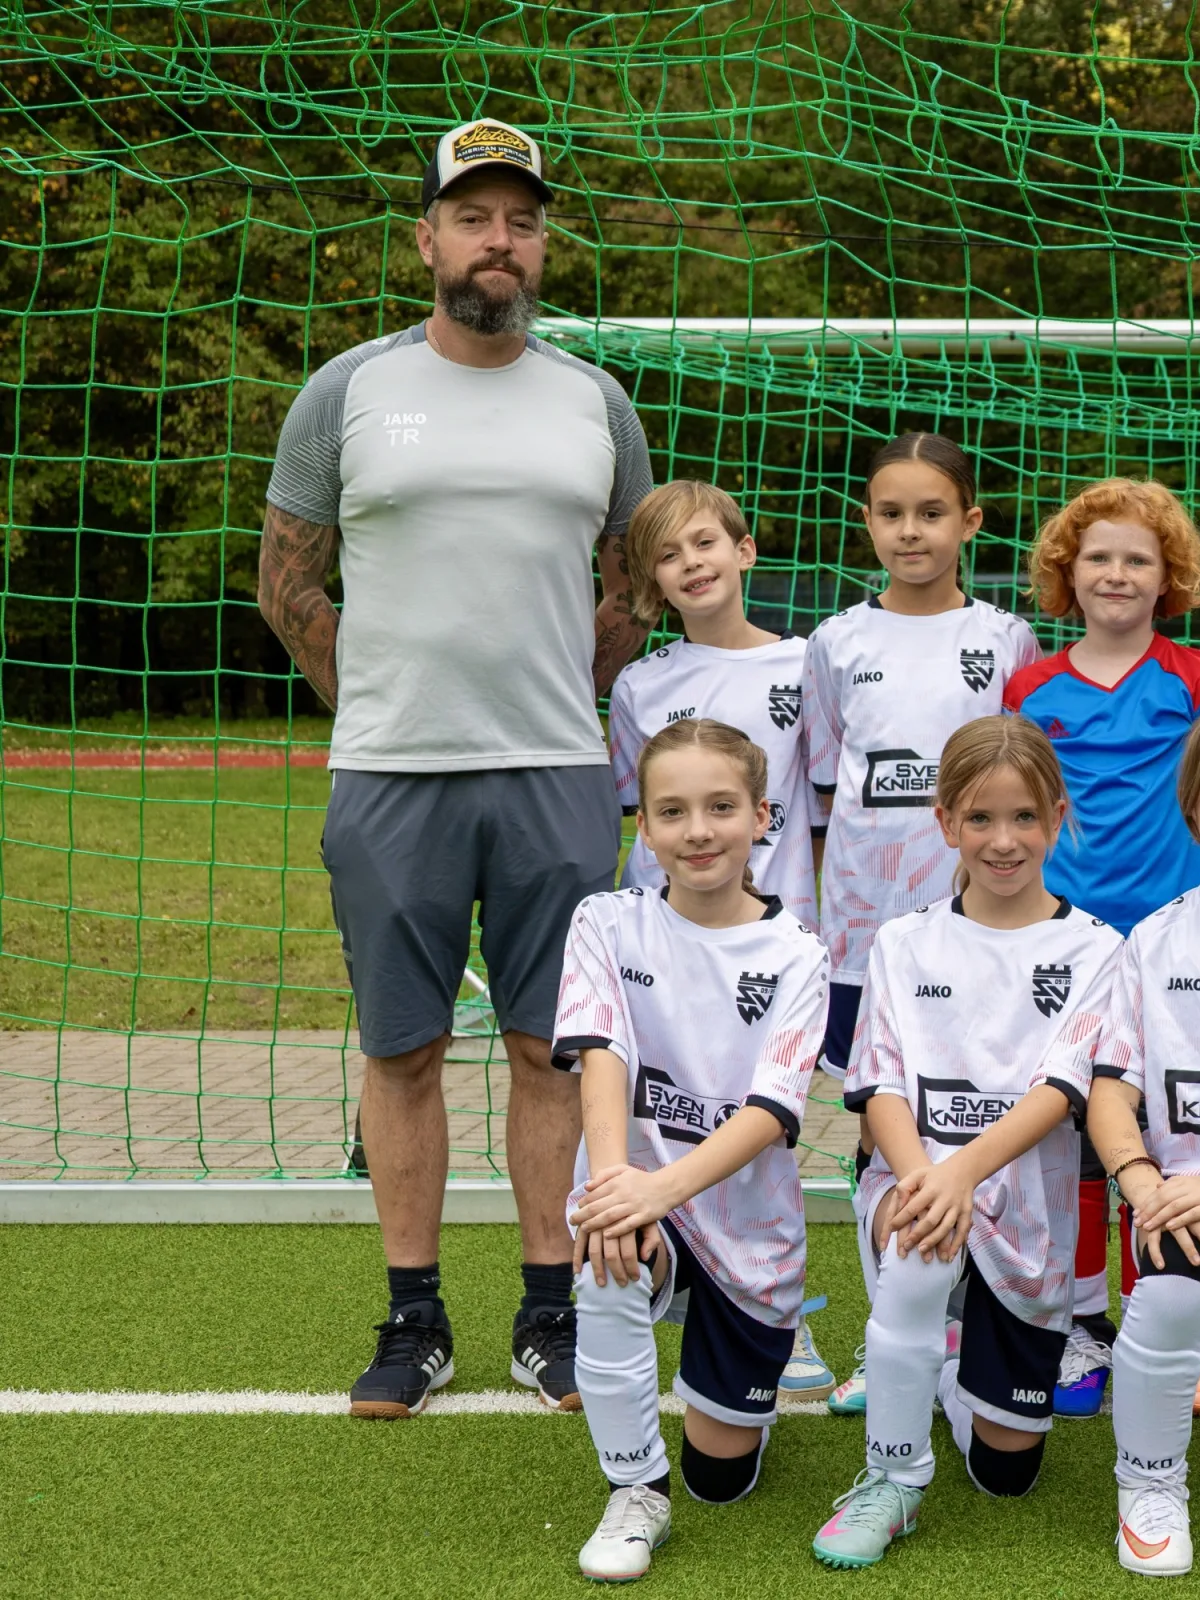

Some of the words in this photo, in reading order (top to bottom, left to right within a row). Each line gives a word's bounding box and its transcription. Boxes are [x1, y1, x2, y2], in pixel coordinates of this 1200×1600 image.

[455, 124, 529, 149] Stetson
[457, 146, 497, 158] AMERICAN
[498, 146, 531, 162] HERITAGE
[383, 413, 427, 426] JAKO
[386, 429, 420, 447] TR
[853, 671, 883, 685] JAKO
[666, 707, 695, 723] JAKO
[896, 763, 940, 777] SVE
[876, 776, 937, 791] KNISP
[915, 985, 952, 998] JAKO
[648, 1084, 704, 1116] SVEN
[950, 1096, 1014, 1113] SVEN
[652, 1102, 711, 1132] ISPEL
[929, 1107, 1004, 1128] KNISP
[1012, 1388, 1047, 1404] JAKO
[604, 1444, 651, 1462] JAKO
[1122, 1451, 1172, 1470] JAKO
